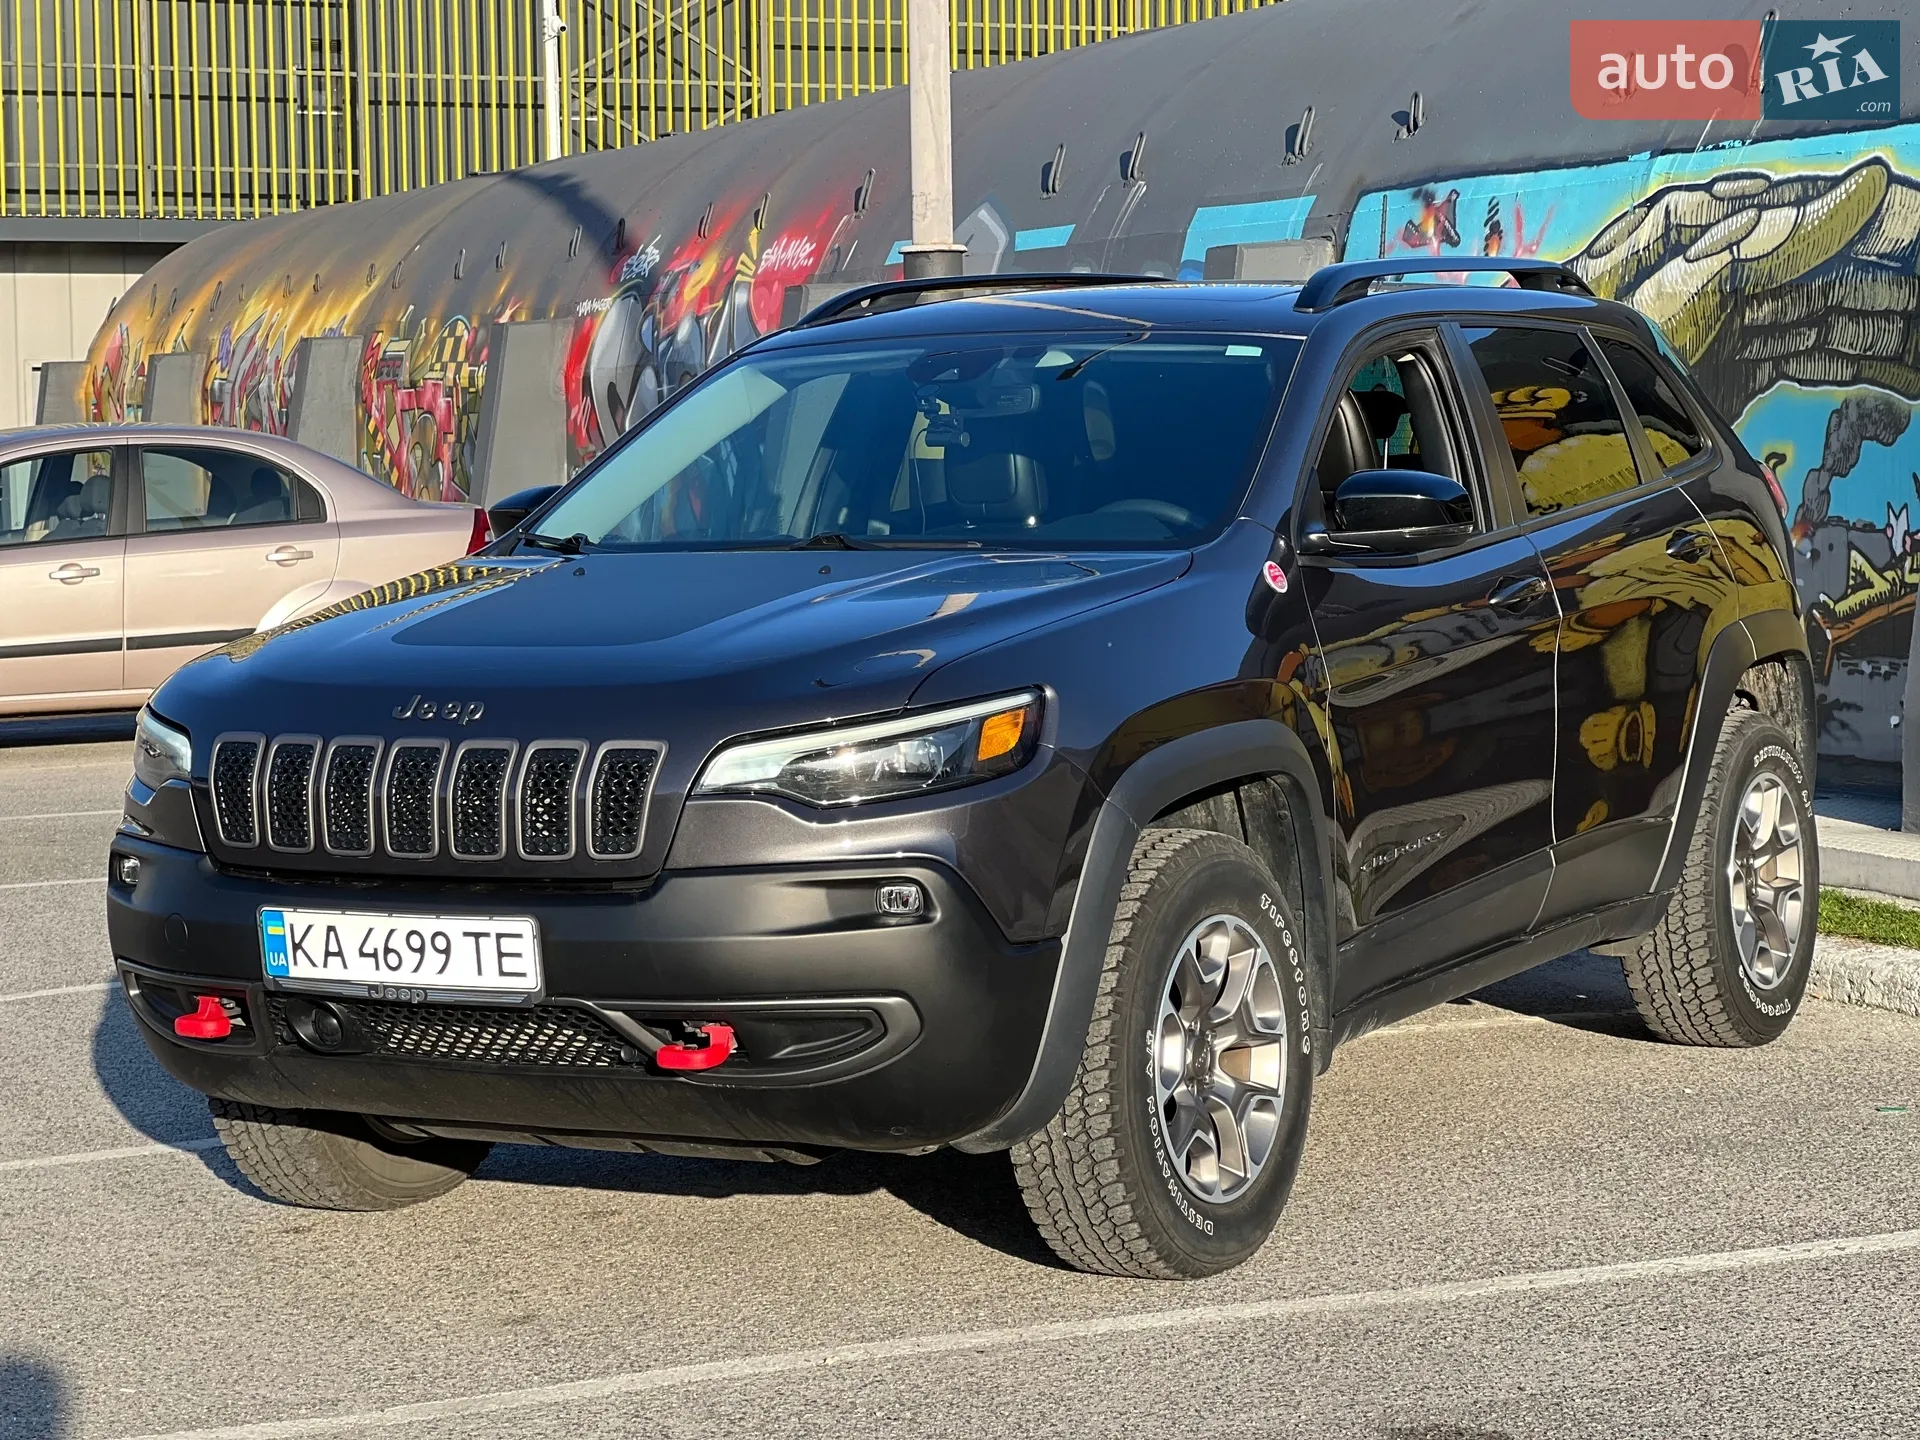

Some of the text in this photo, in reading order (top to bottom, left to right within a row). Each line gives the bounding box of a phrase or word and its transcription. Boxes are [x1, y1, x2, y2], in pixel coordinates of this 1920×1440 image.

[392, 694, 485, 726] Jeep
[269, 951, 288, 967] UA
[289, 923, 528, 978] KA 4699 TE
[370, 982, 427, 1004] Jeep
[1146, 1096, 1214, 1236] DESTINATION
